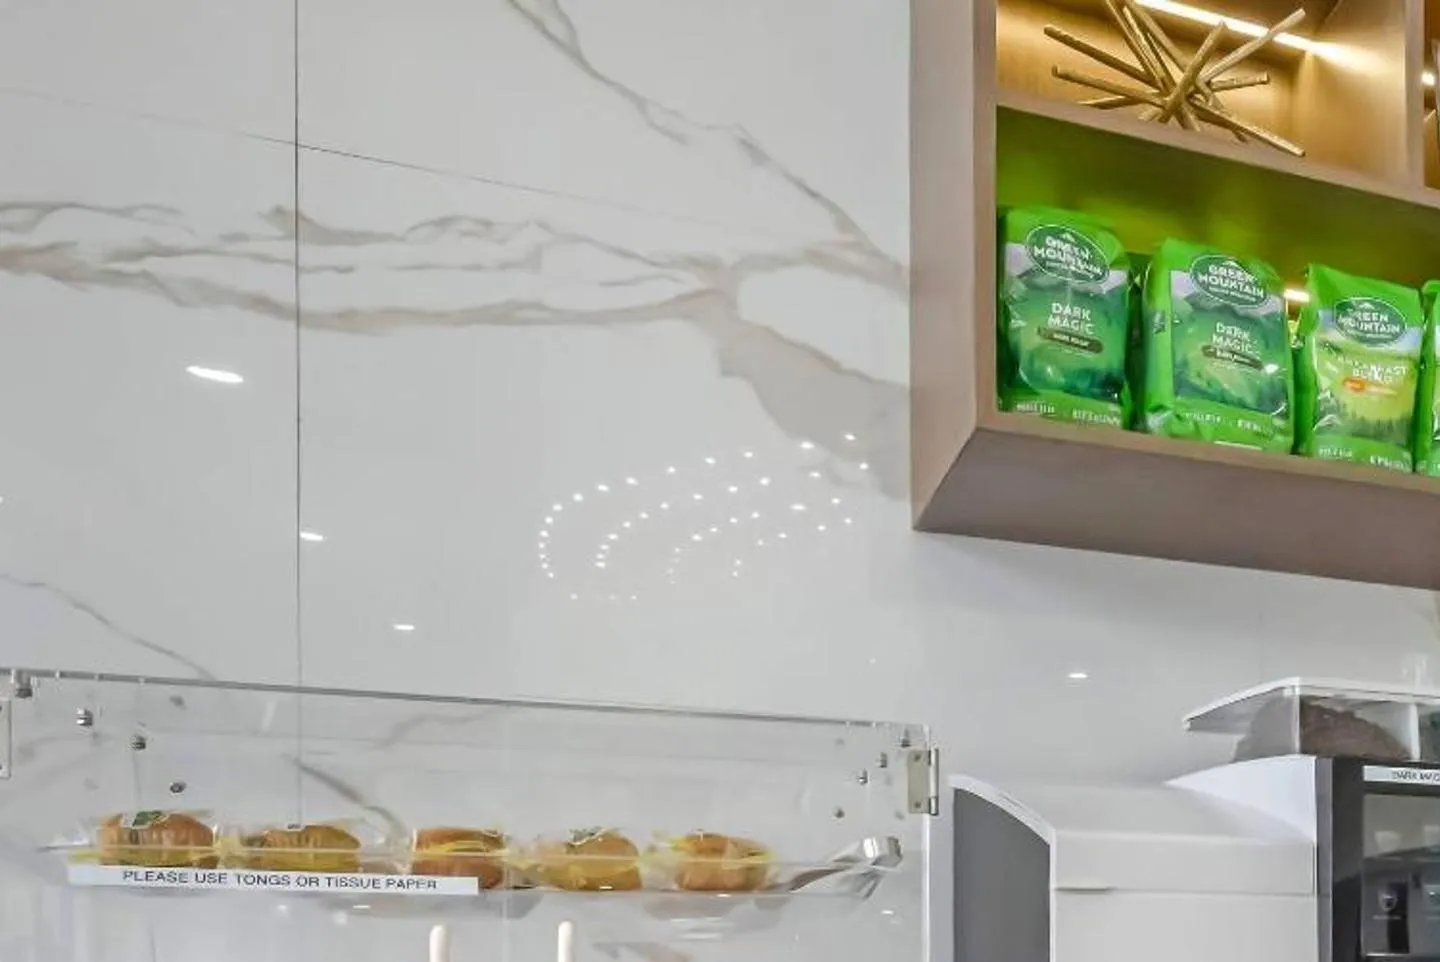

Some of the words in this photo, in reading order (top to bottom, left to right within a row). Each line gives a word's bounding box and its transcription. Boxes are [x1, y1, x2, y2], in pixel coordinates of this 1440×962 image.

[1198, 273, 1264, 298] MOUNTAIN
[1051, 302, 1091, 321] DARK
[1048, 314, 1095, 335] MAGIC
[1216, 322, 1250, 341] DARK
[122, 870, 189, 884] PLEASE
[194, 872, 228, 885] USE
[235, 873, 291, 887] TONGS
[296, 875, 320, 888] OR
[325, 875, 382, 889] TISSUE
[385, 877, 437, 890] PAPER
